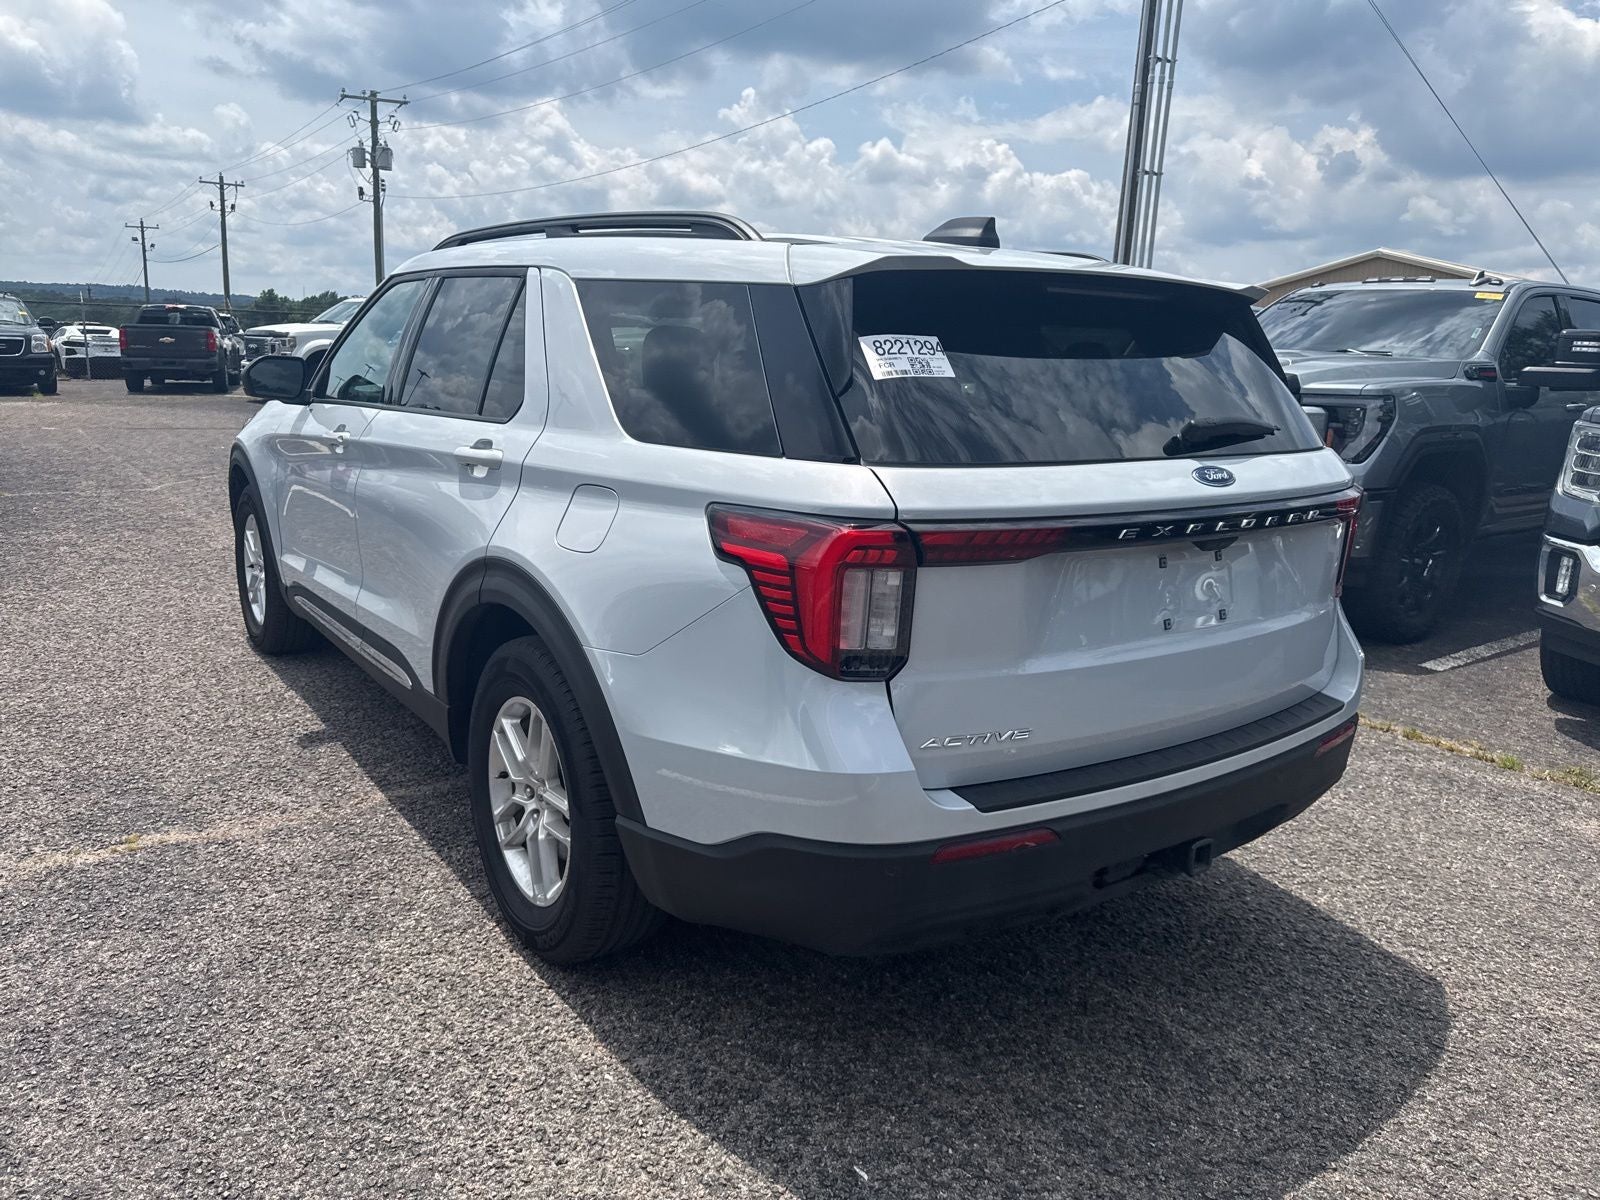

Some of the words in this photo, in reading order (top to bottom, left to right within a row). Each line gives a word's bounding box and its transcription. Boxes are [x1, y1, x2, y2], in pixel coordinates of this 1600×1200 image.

[872, 339, 946, 356] 8221294
[1204, 468, 1230, 481] Ford
[1118, 509, 1320, 540] EXPLORER
[919, 728, 1033, 749] ACTIVE
